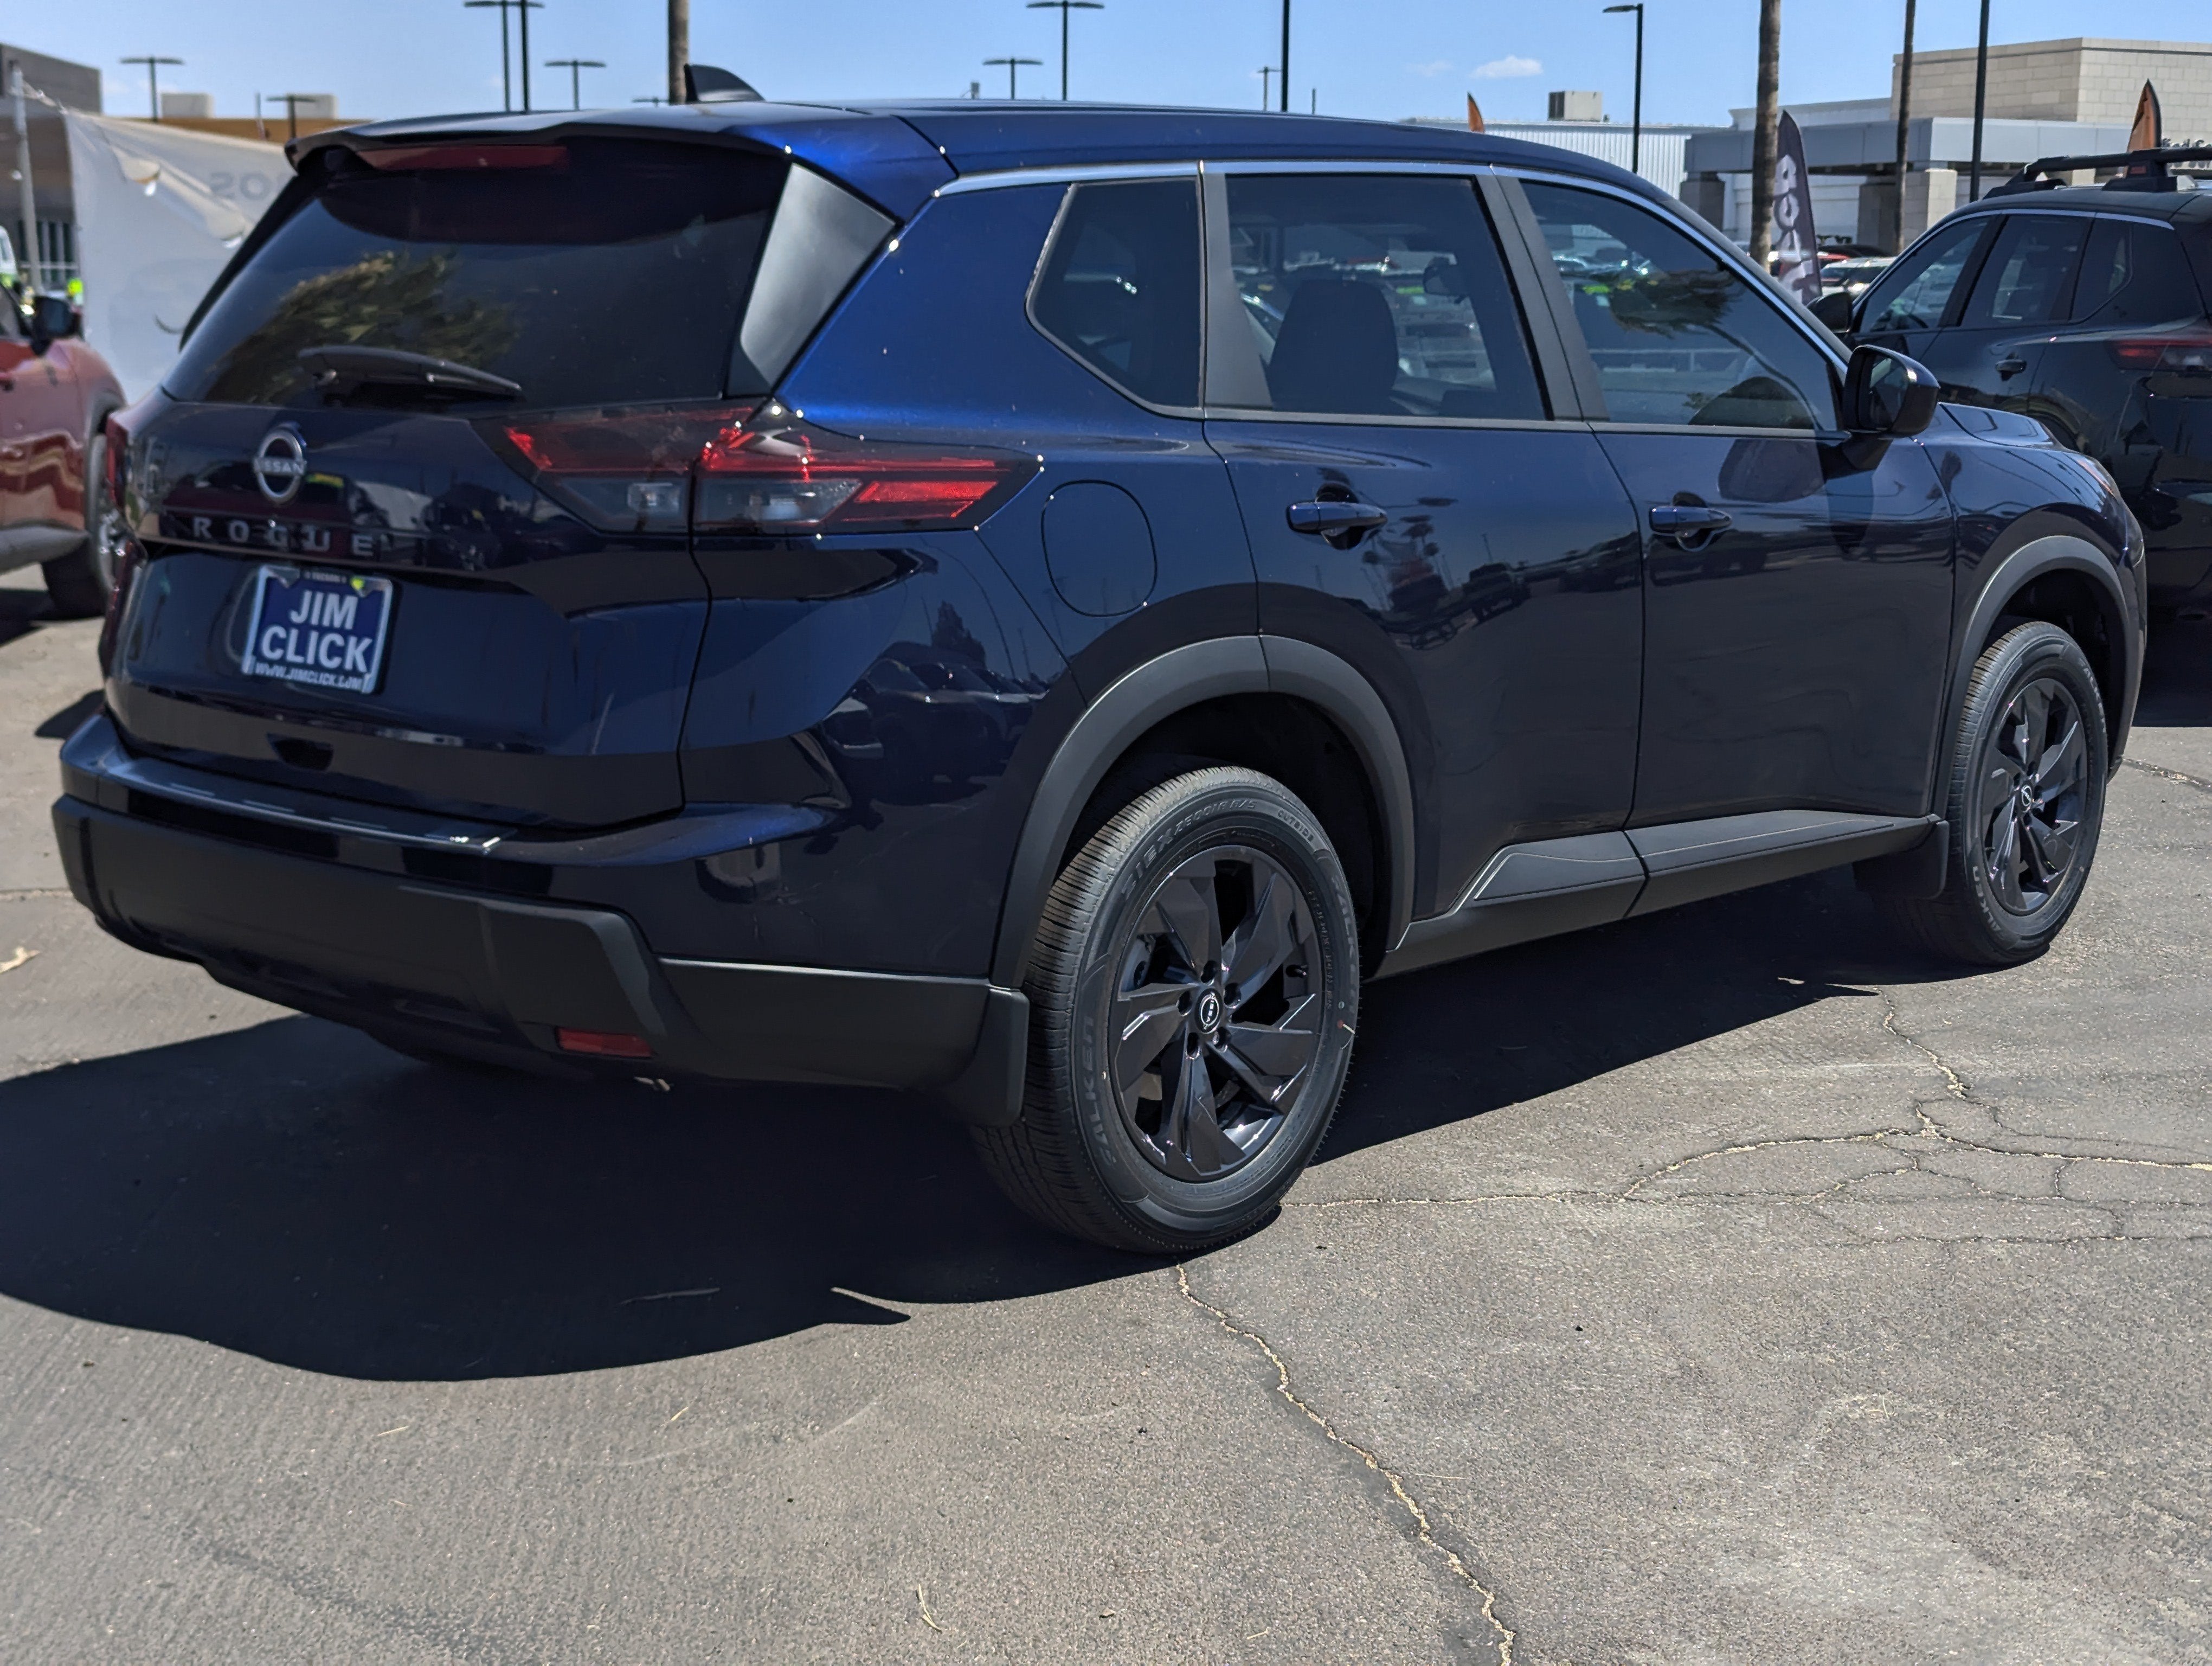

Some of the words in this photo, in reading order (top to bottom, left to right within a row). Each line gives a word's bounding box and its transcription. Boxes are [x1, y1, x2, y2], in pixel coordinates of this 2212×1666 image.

[193, 515, 374, 556] ROGUE
[290, 589, 358, 630] JIM
[261, 625, 372, 673] CLICK
[1277, 809, 1314, 842] OUTSIDE
[1203, 991, 1215, 1030] NISSAN
